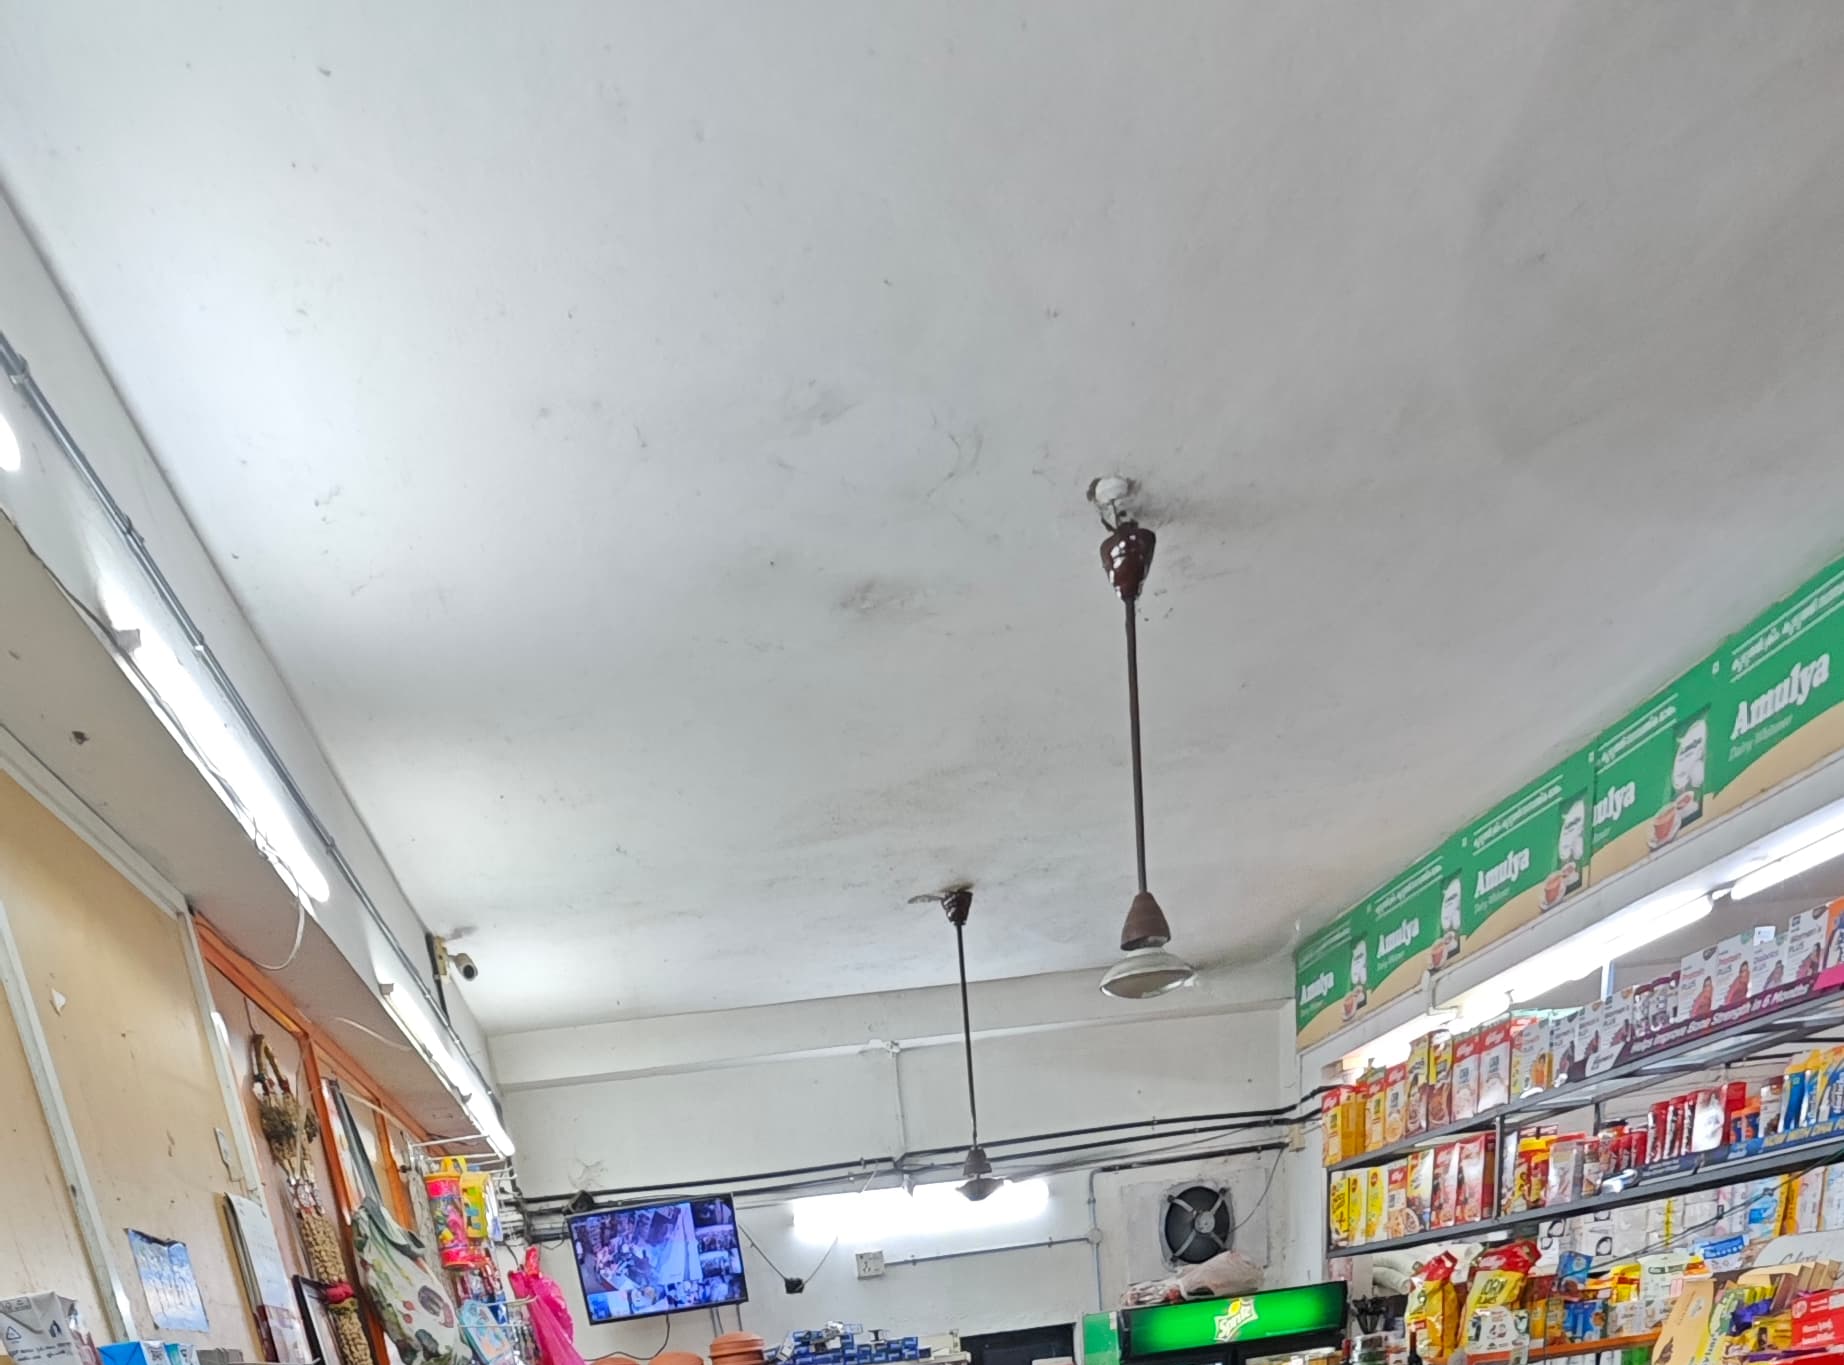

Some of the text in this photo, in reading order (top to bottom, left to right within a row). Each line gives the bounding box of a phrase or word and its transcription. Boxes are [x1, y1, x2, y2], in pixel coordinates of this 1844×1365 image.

[1730, 653, 1830, 740] Amulya
[1474, 848, 1530, 899] Amulya
[1377, 918, 1420, 958] Amulya
